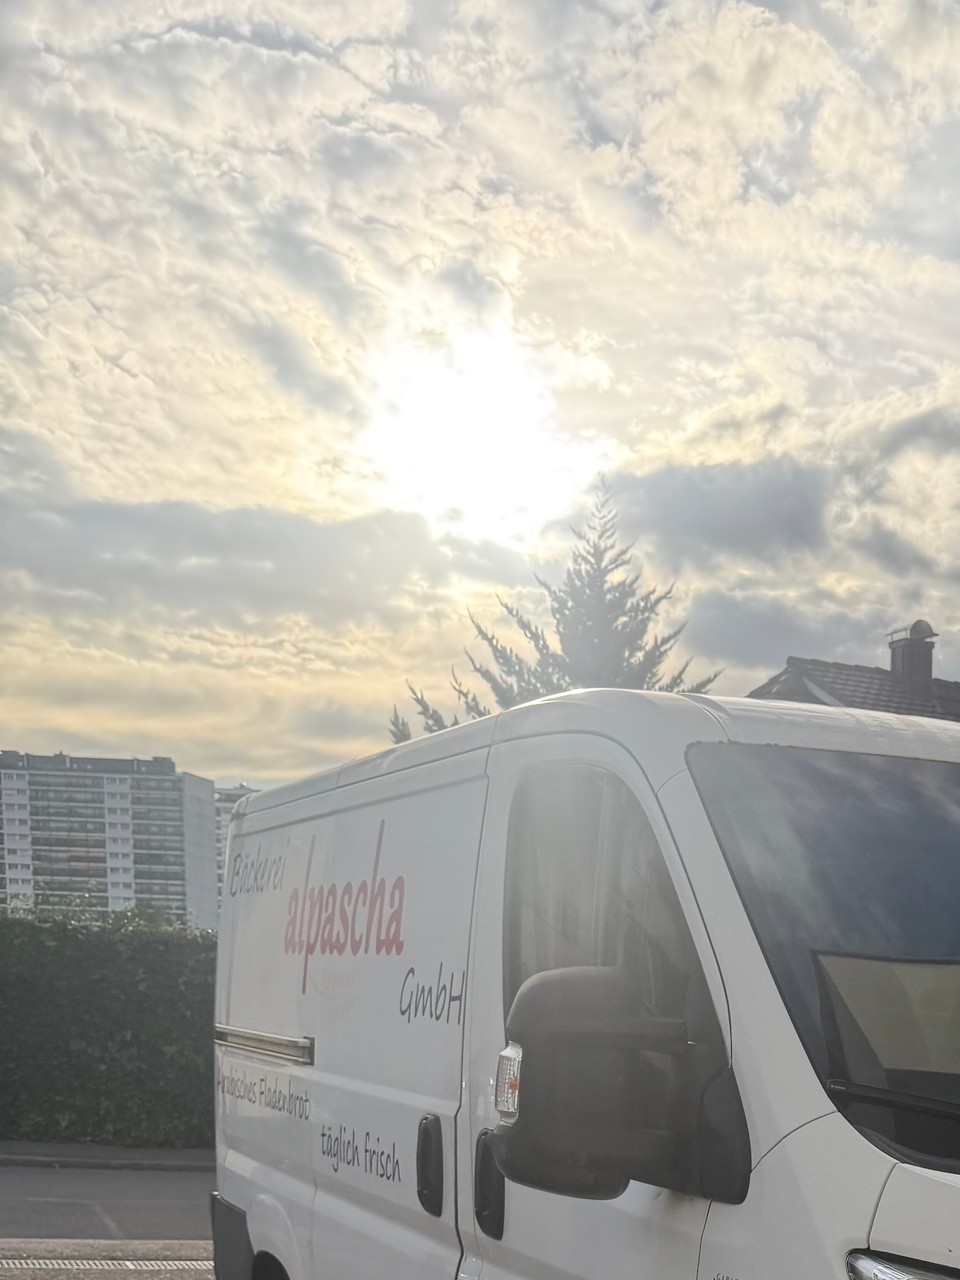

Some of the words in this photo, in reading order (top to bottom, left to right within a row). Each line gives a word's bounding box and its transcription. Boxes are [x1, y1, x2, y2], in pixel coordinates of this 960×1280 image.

[230, 837, 290, 898] Bäckerei
[284, 819, 405, 995] alpascha
[400, 961, 466, 1026] GmbH
[259, 1075, 310, 1120] Fladenbrot
[321, 1124, 360, 1173] täglich
[364, 1131, 401, 1182] frisch
